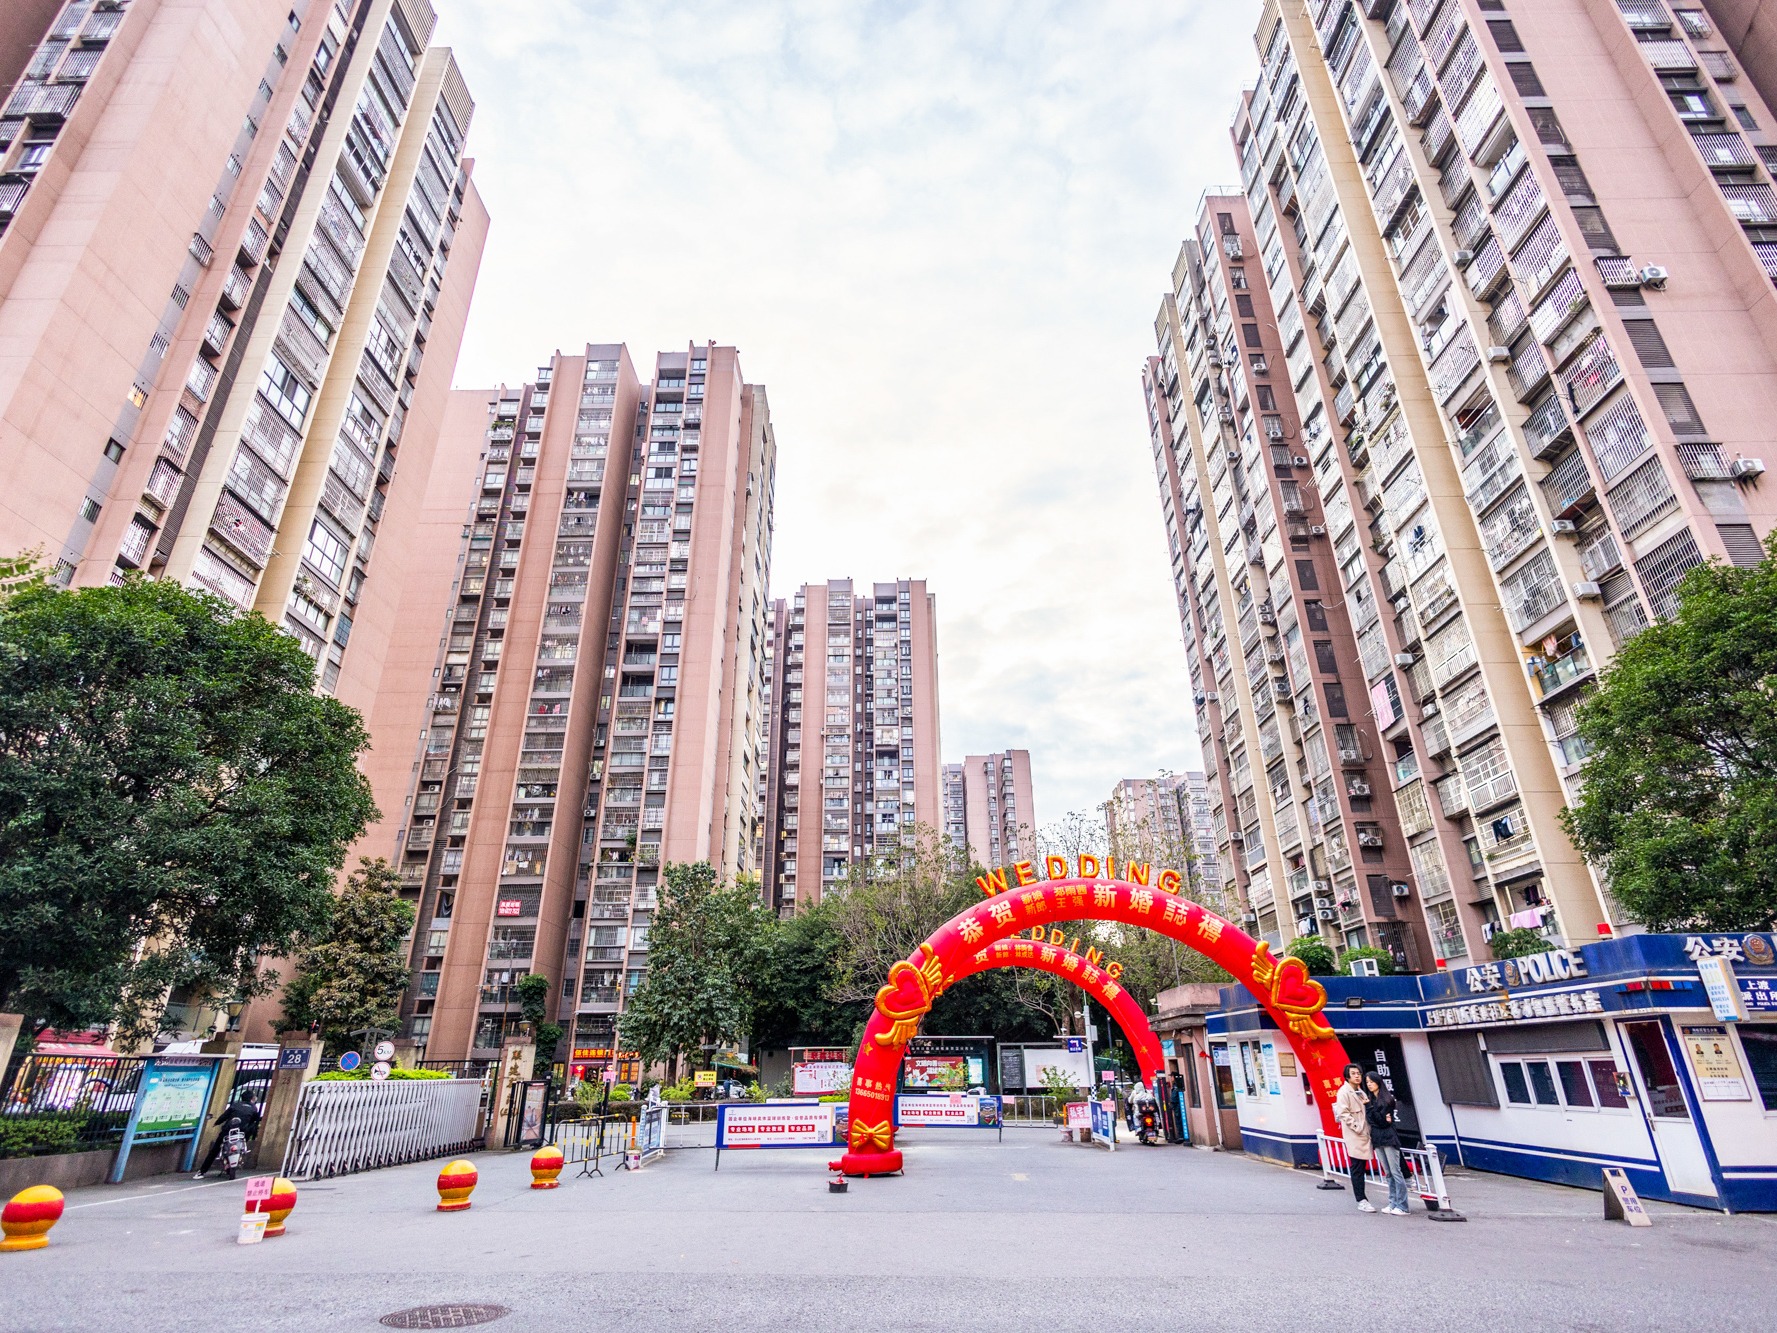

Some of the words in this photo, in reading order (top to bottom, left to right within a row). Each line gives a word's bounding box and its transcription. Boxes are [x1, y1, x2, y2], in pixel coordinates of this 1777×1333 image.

[976, 853, 1182, 898] WEDDING
[1021, 890, 1044, 904] 新娘
[1025, 901, 1047, 915] 新郎
[957, 900, 1016, 944] 恭贺
[1683, 936, 1745, 962] 公安
[1466, 964, 1502, 993] 公安
[1516, 946, 1588, 985] POLICE
[1746, 980, 1770, 990] 上渡
[287, 1054, 302, 1064] 28
[1620, 1185, 1628, 1194] P
